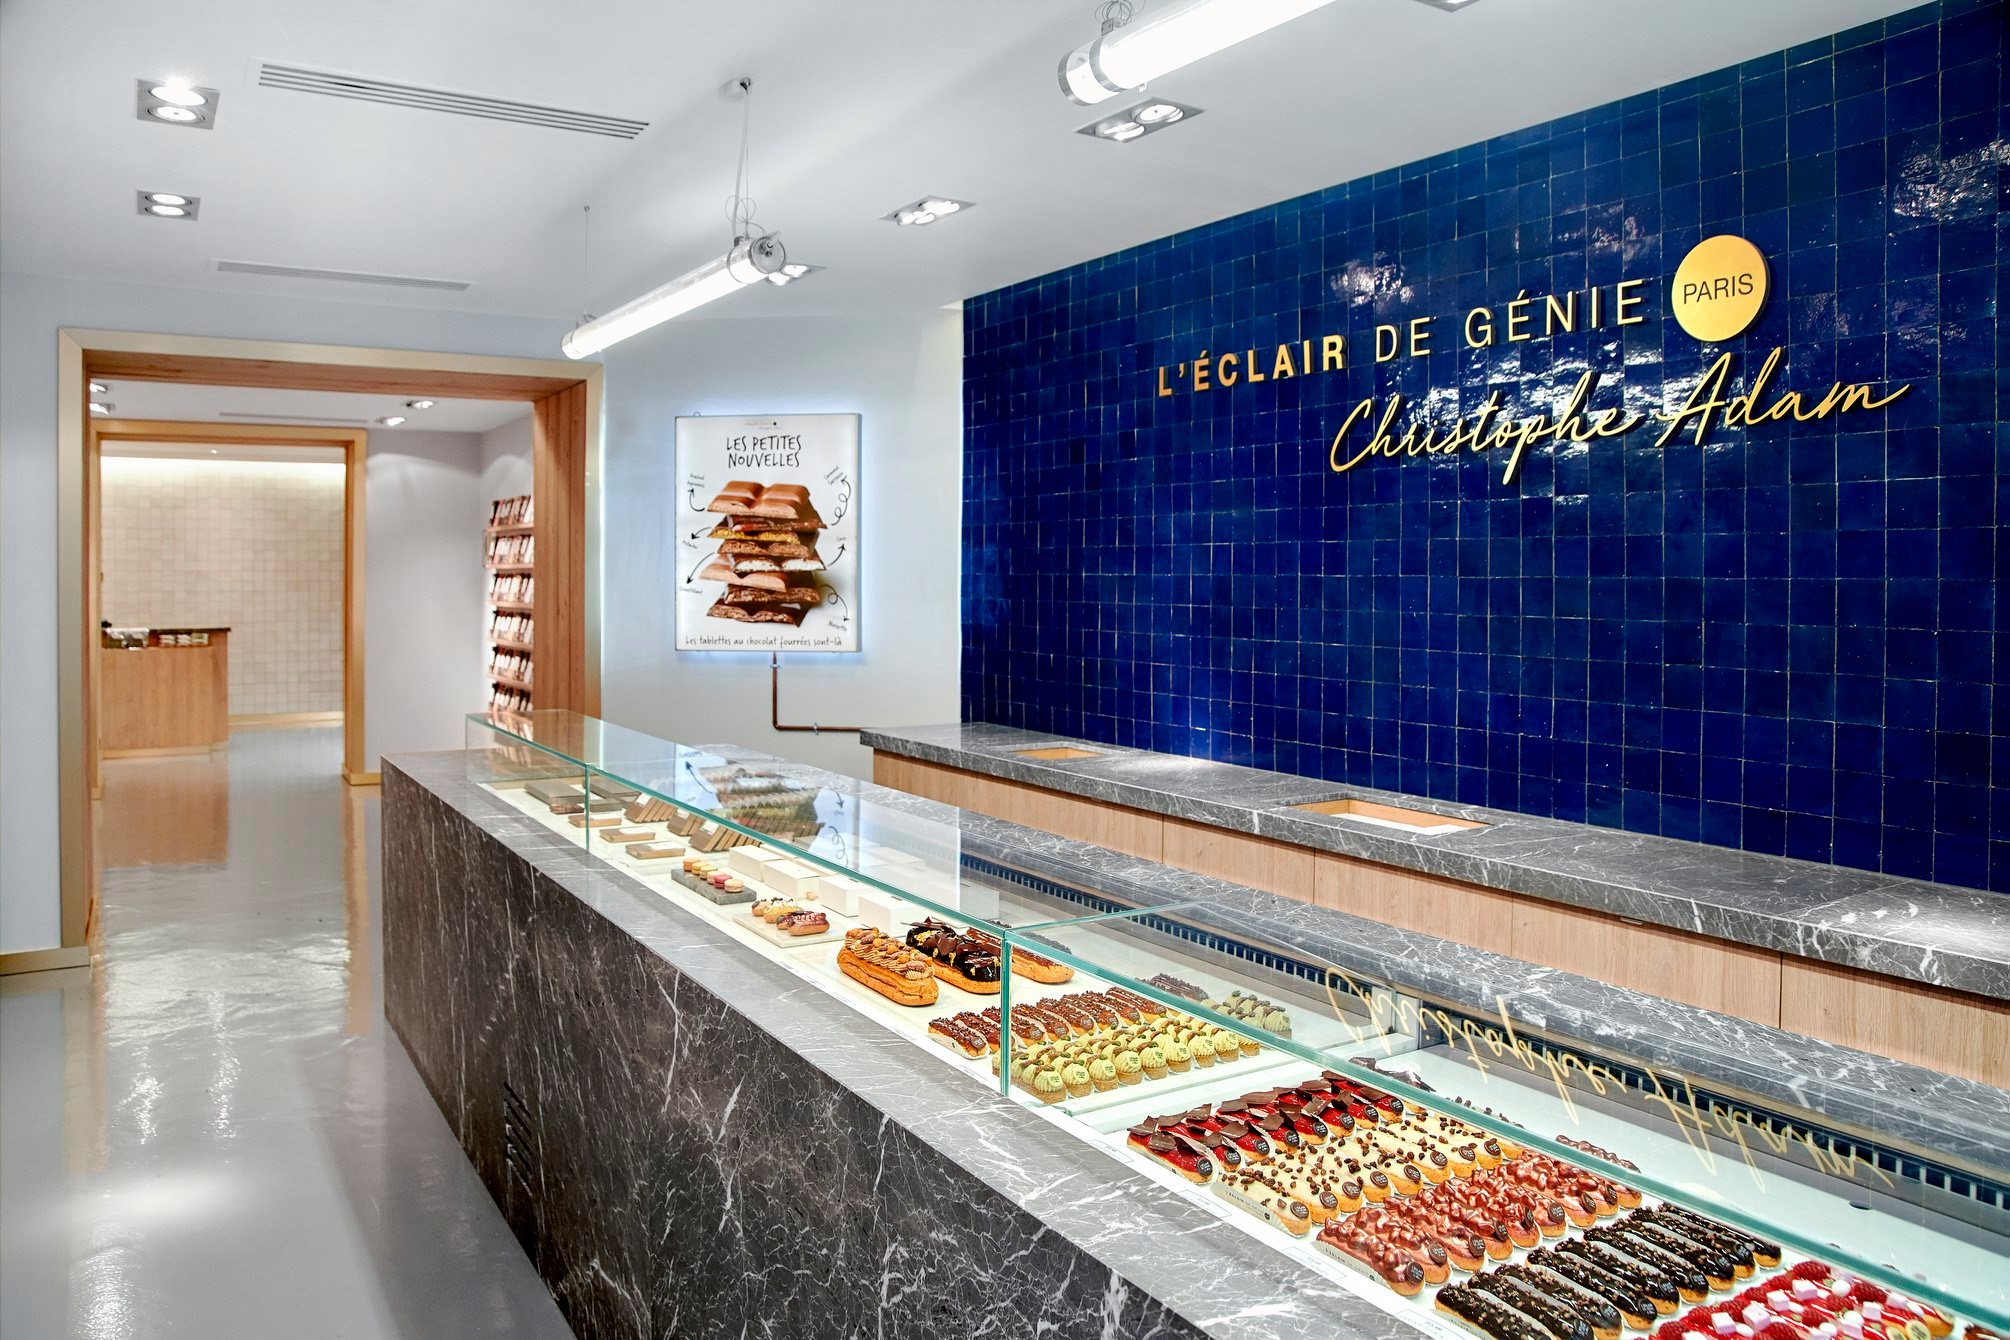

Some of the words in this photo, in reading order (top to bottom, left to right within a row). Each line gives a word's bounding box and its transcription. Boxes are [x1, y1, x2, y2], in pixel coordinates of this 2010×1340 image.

[1682, 272, 1755, 304] PARIS
[1157, 334, 1347, 398] L'ÉCLAIR
[1373, 314, 1434, 363] DE
[1465, 278, 1647, 349] GÉNIE
[1329, 370, 1654, 485] Christophe
[1655, 347, 1912, 447] Adam
[726, 435, 747, 452] LES
[752, 434, 802, 452] PETITES
[728, 452, 801, 469] NOUVELLES
[685, 635, 697, 645] Les
[699, 634, 731, 645] tablettes
[733, 637, 744, 645] au
[746, 634, 777, 645] chocolat
[780, 634, 811, 648] fourrées
